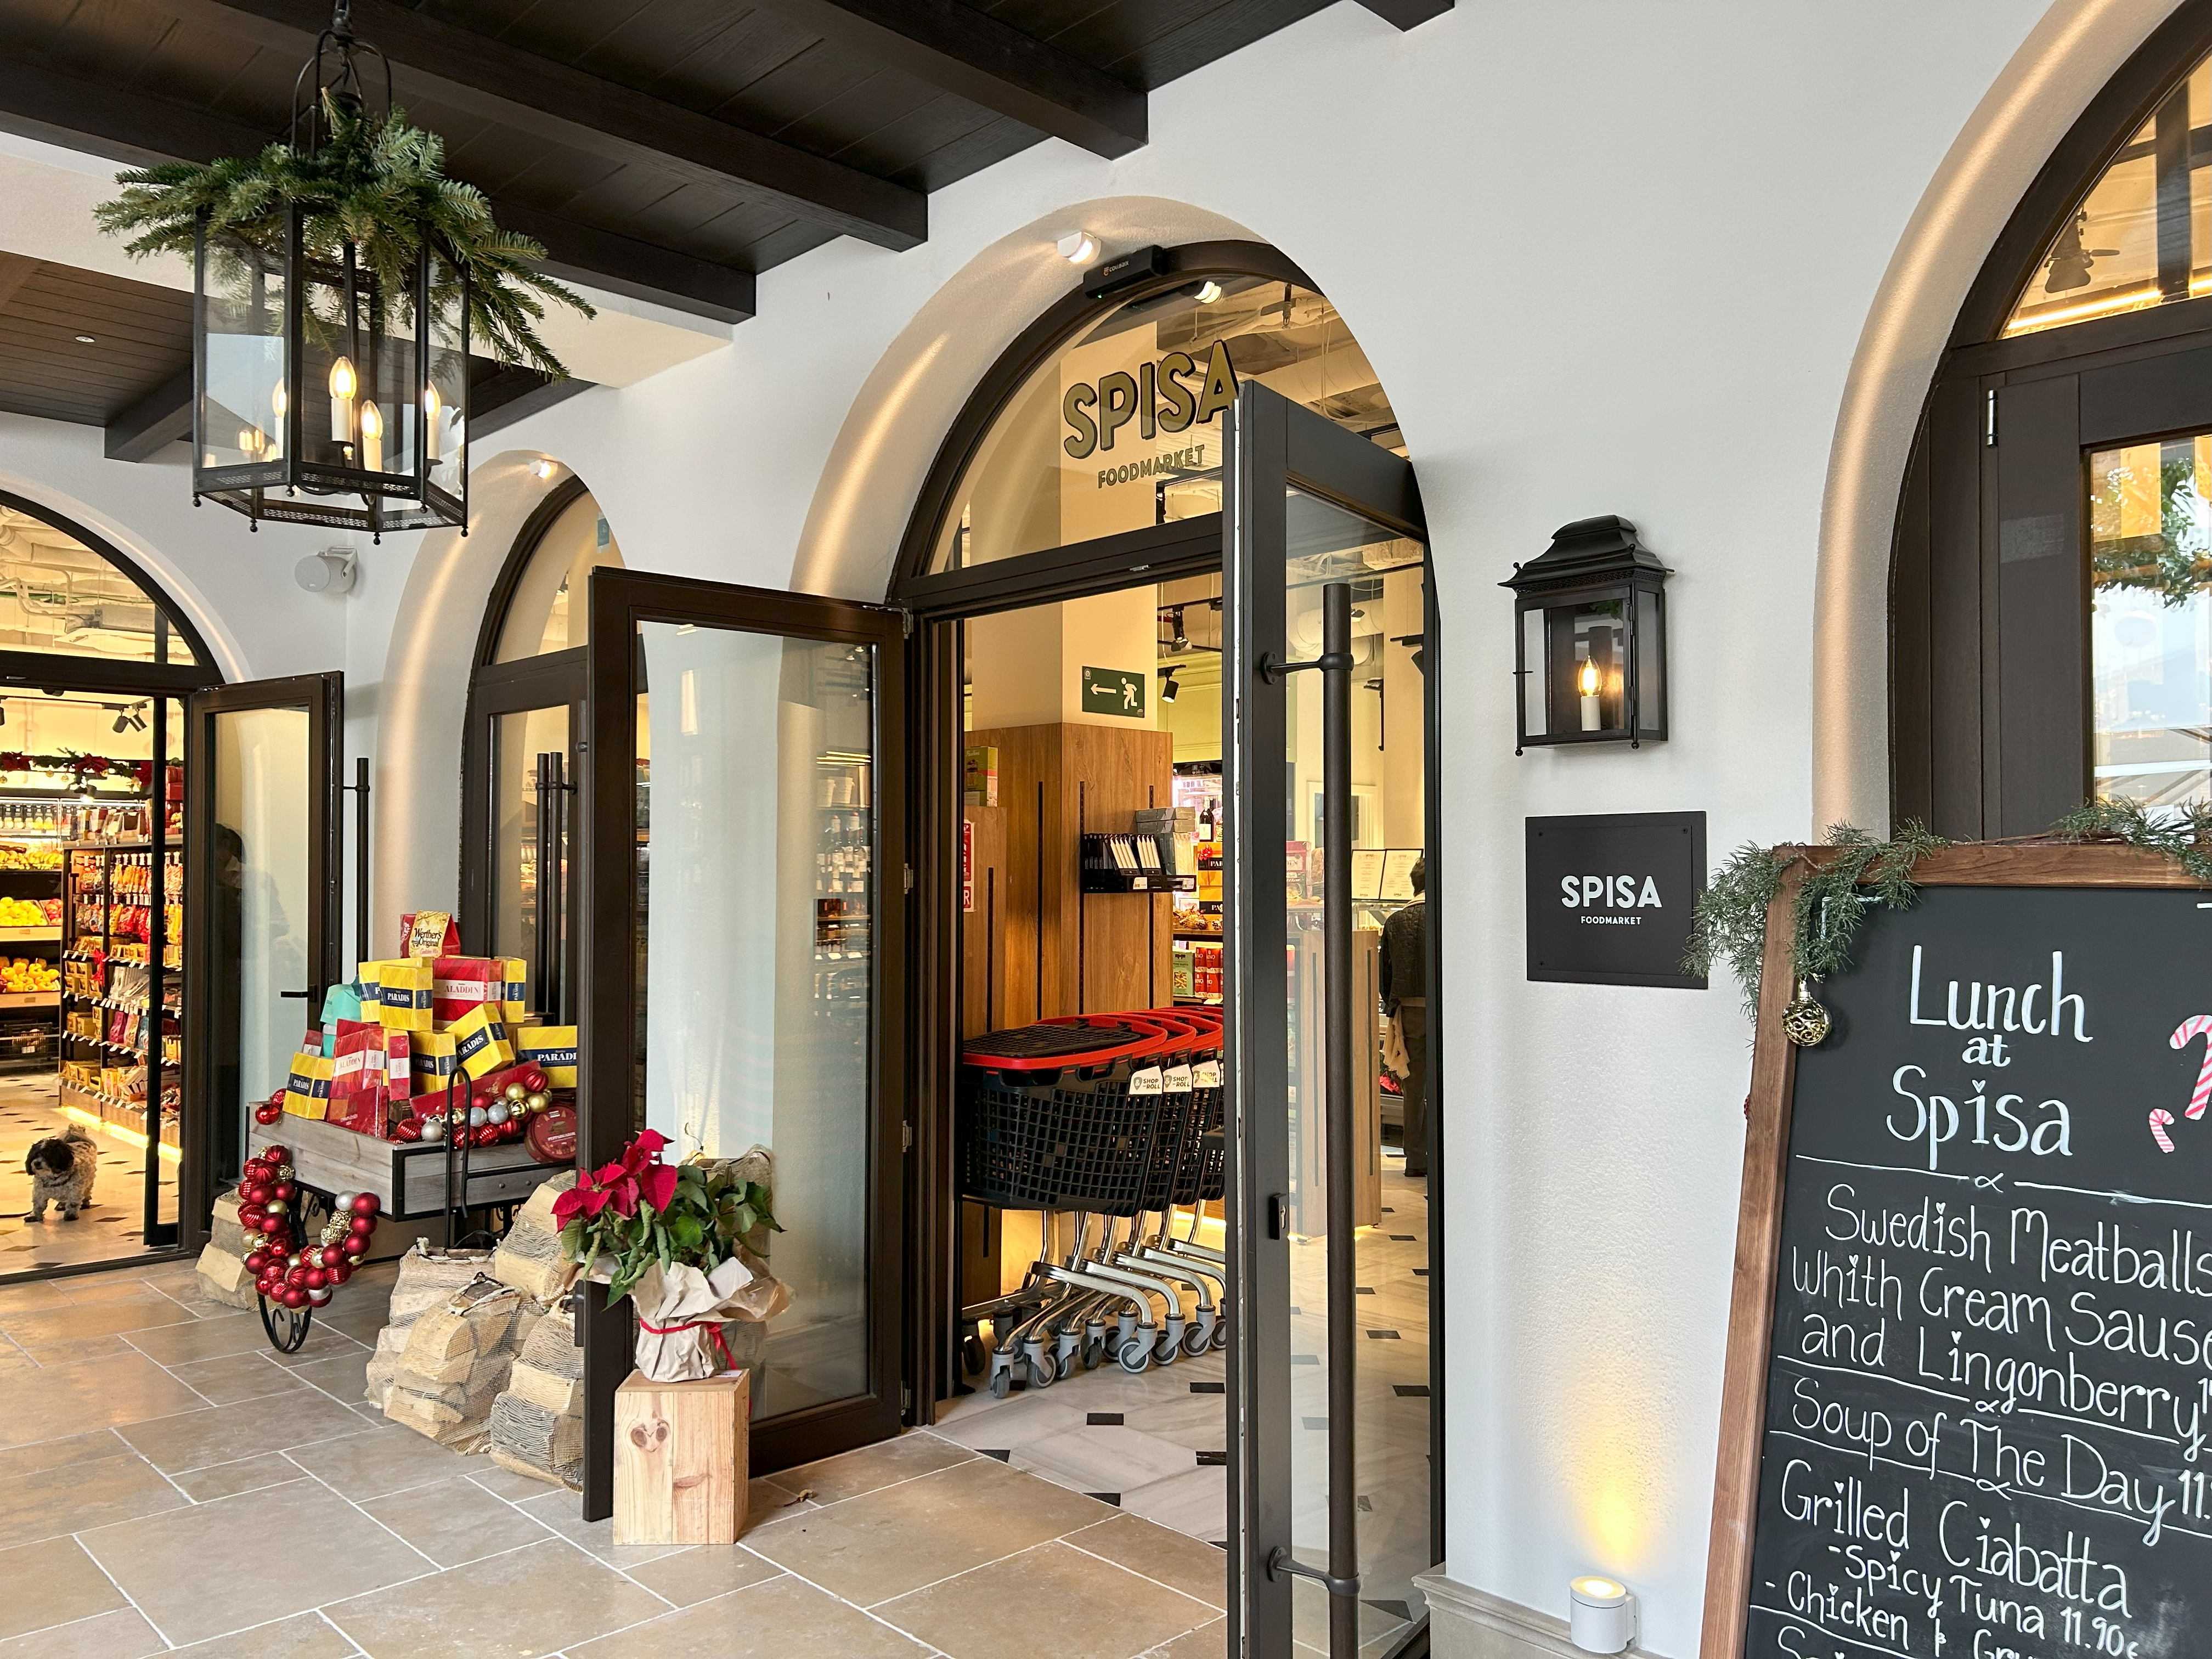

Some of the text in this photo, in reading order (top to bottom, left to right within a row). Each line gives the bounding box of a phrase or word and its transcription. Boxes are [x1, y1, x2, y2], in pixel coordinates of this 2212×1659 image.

[1063, 339, 1239, 459] SPISA
[1098, 444, 1205, 488] FOODMARKET
[1561, 875, 1662, 908] SPISA
[1581, 916, 1641, 925] FOODMARKET
[387, 993, 410, 1002] PARADIS
[444, 985, 479, 994] ALADDIN
[1910, 945, 2094, 1042] Lunch
[456, 1034, 484, 1058] ARADIS
[1962, 1034, 2011, 1067] at
[1887, 1065, 2073, 1170] Spisa
[1825, 1183, 2212, 1297] Swedish Meatballs
[1920, 1267, 2056, 1352] Cream
[1802, 1314, 1885, 1367] and
[1918, 1326, 2207, 1462] Lingonberry
[1792, 1377, 1892, 1471] Soup
[1905, 1412, 1947, 1480] of
[1960, 1418, 2046, 1487] The
[2062, 1434, 2176, 1547] Day
[1781, 1459, 2132, 1618] Grilled Ciabatta
[1787, 1571, 1909, 1650] Chicken
[1950, 1575, 2045, 1640] Tuna
